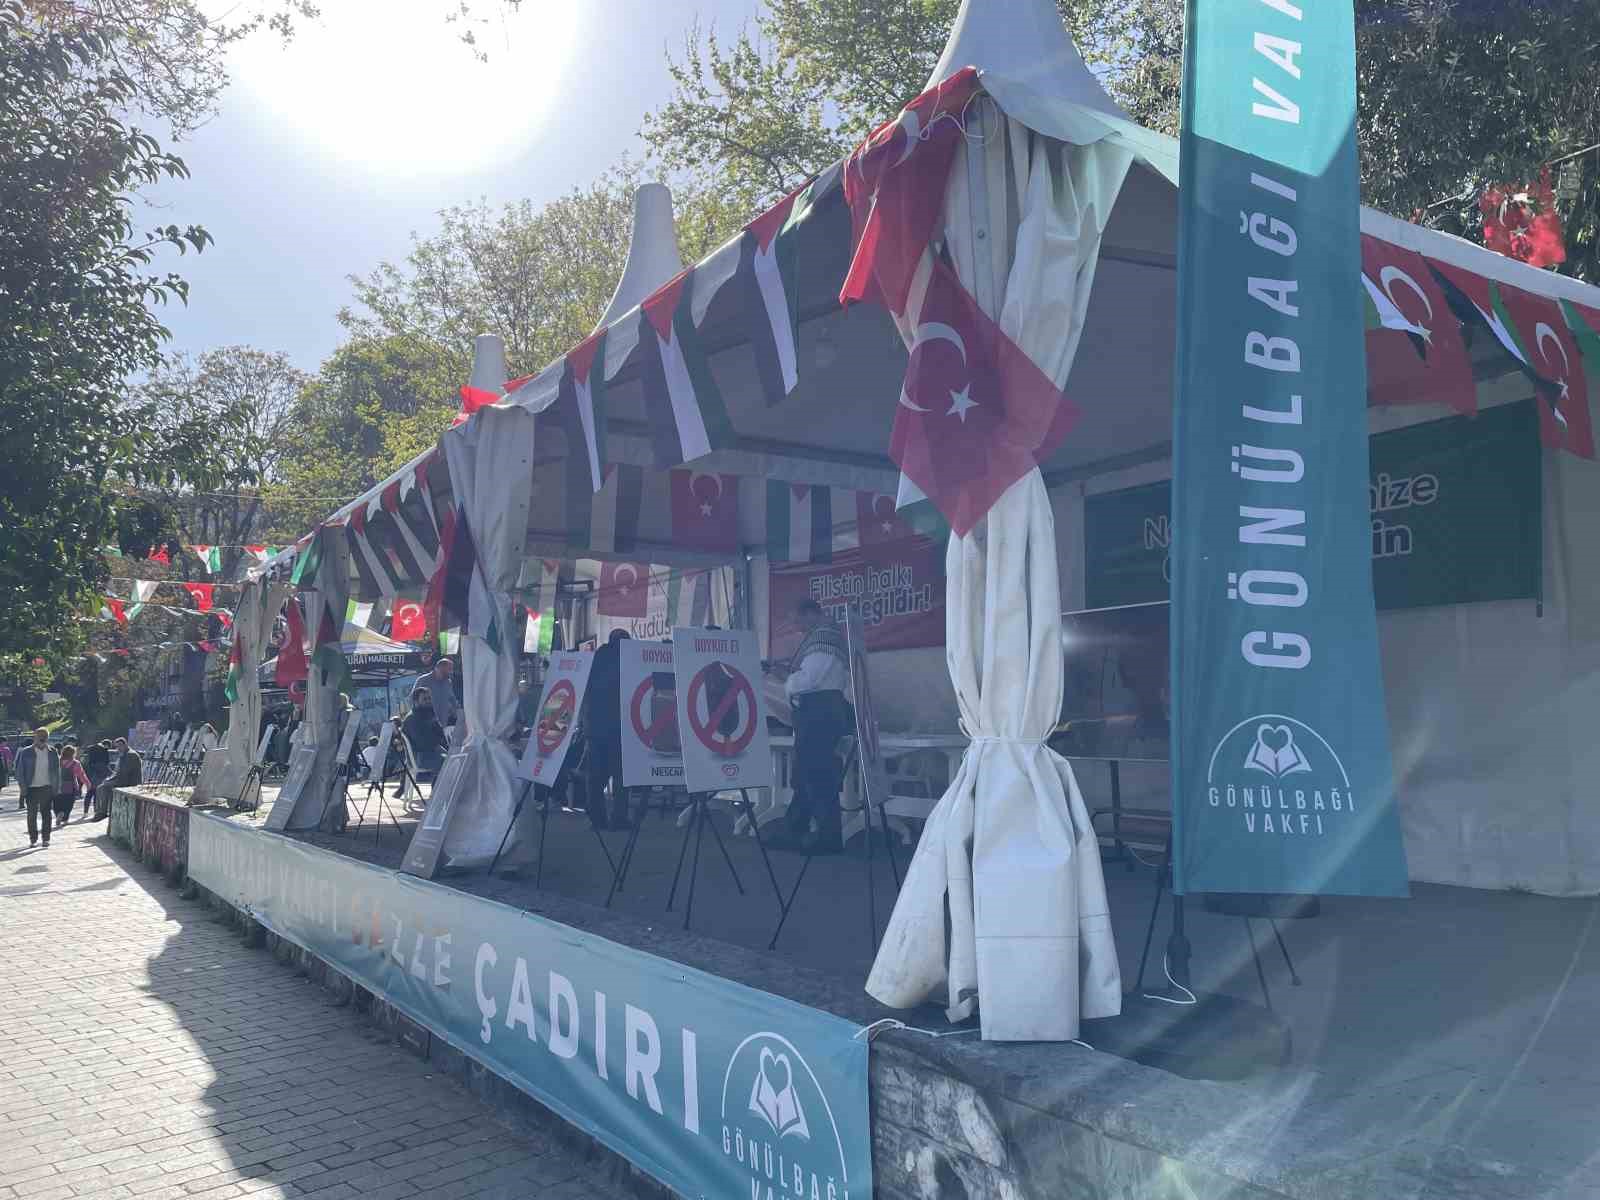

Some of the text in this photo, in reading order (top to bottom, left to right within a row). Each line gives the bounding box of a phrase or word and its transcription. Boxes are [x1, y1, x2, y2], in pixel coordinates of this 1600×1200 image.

[1228, 172, 1311, 669] GÖNÜLBAĞI
[1370, 519, 1412, 558] in
[809, 560, 912, 602] Filistin halkı
[641, 647, 672, 664] BOYKO
[1208, 785, 1354, 812] GÖNÜLBAĞI
[1246, 813, 1324, 835] VAKFI
[475, 942, 699, 1135] ÇADIRI
[722, 1125, 849, 1200] GÖNÜLBAĞ
